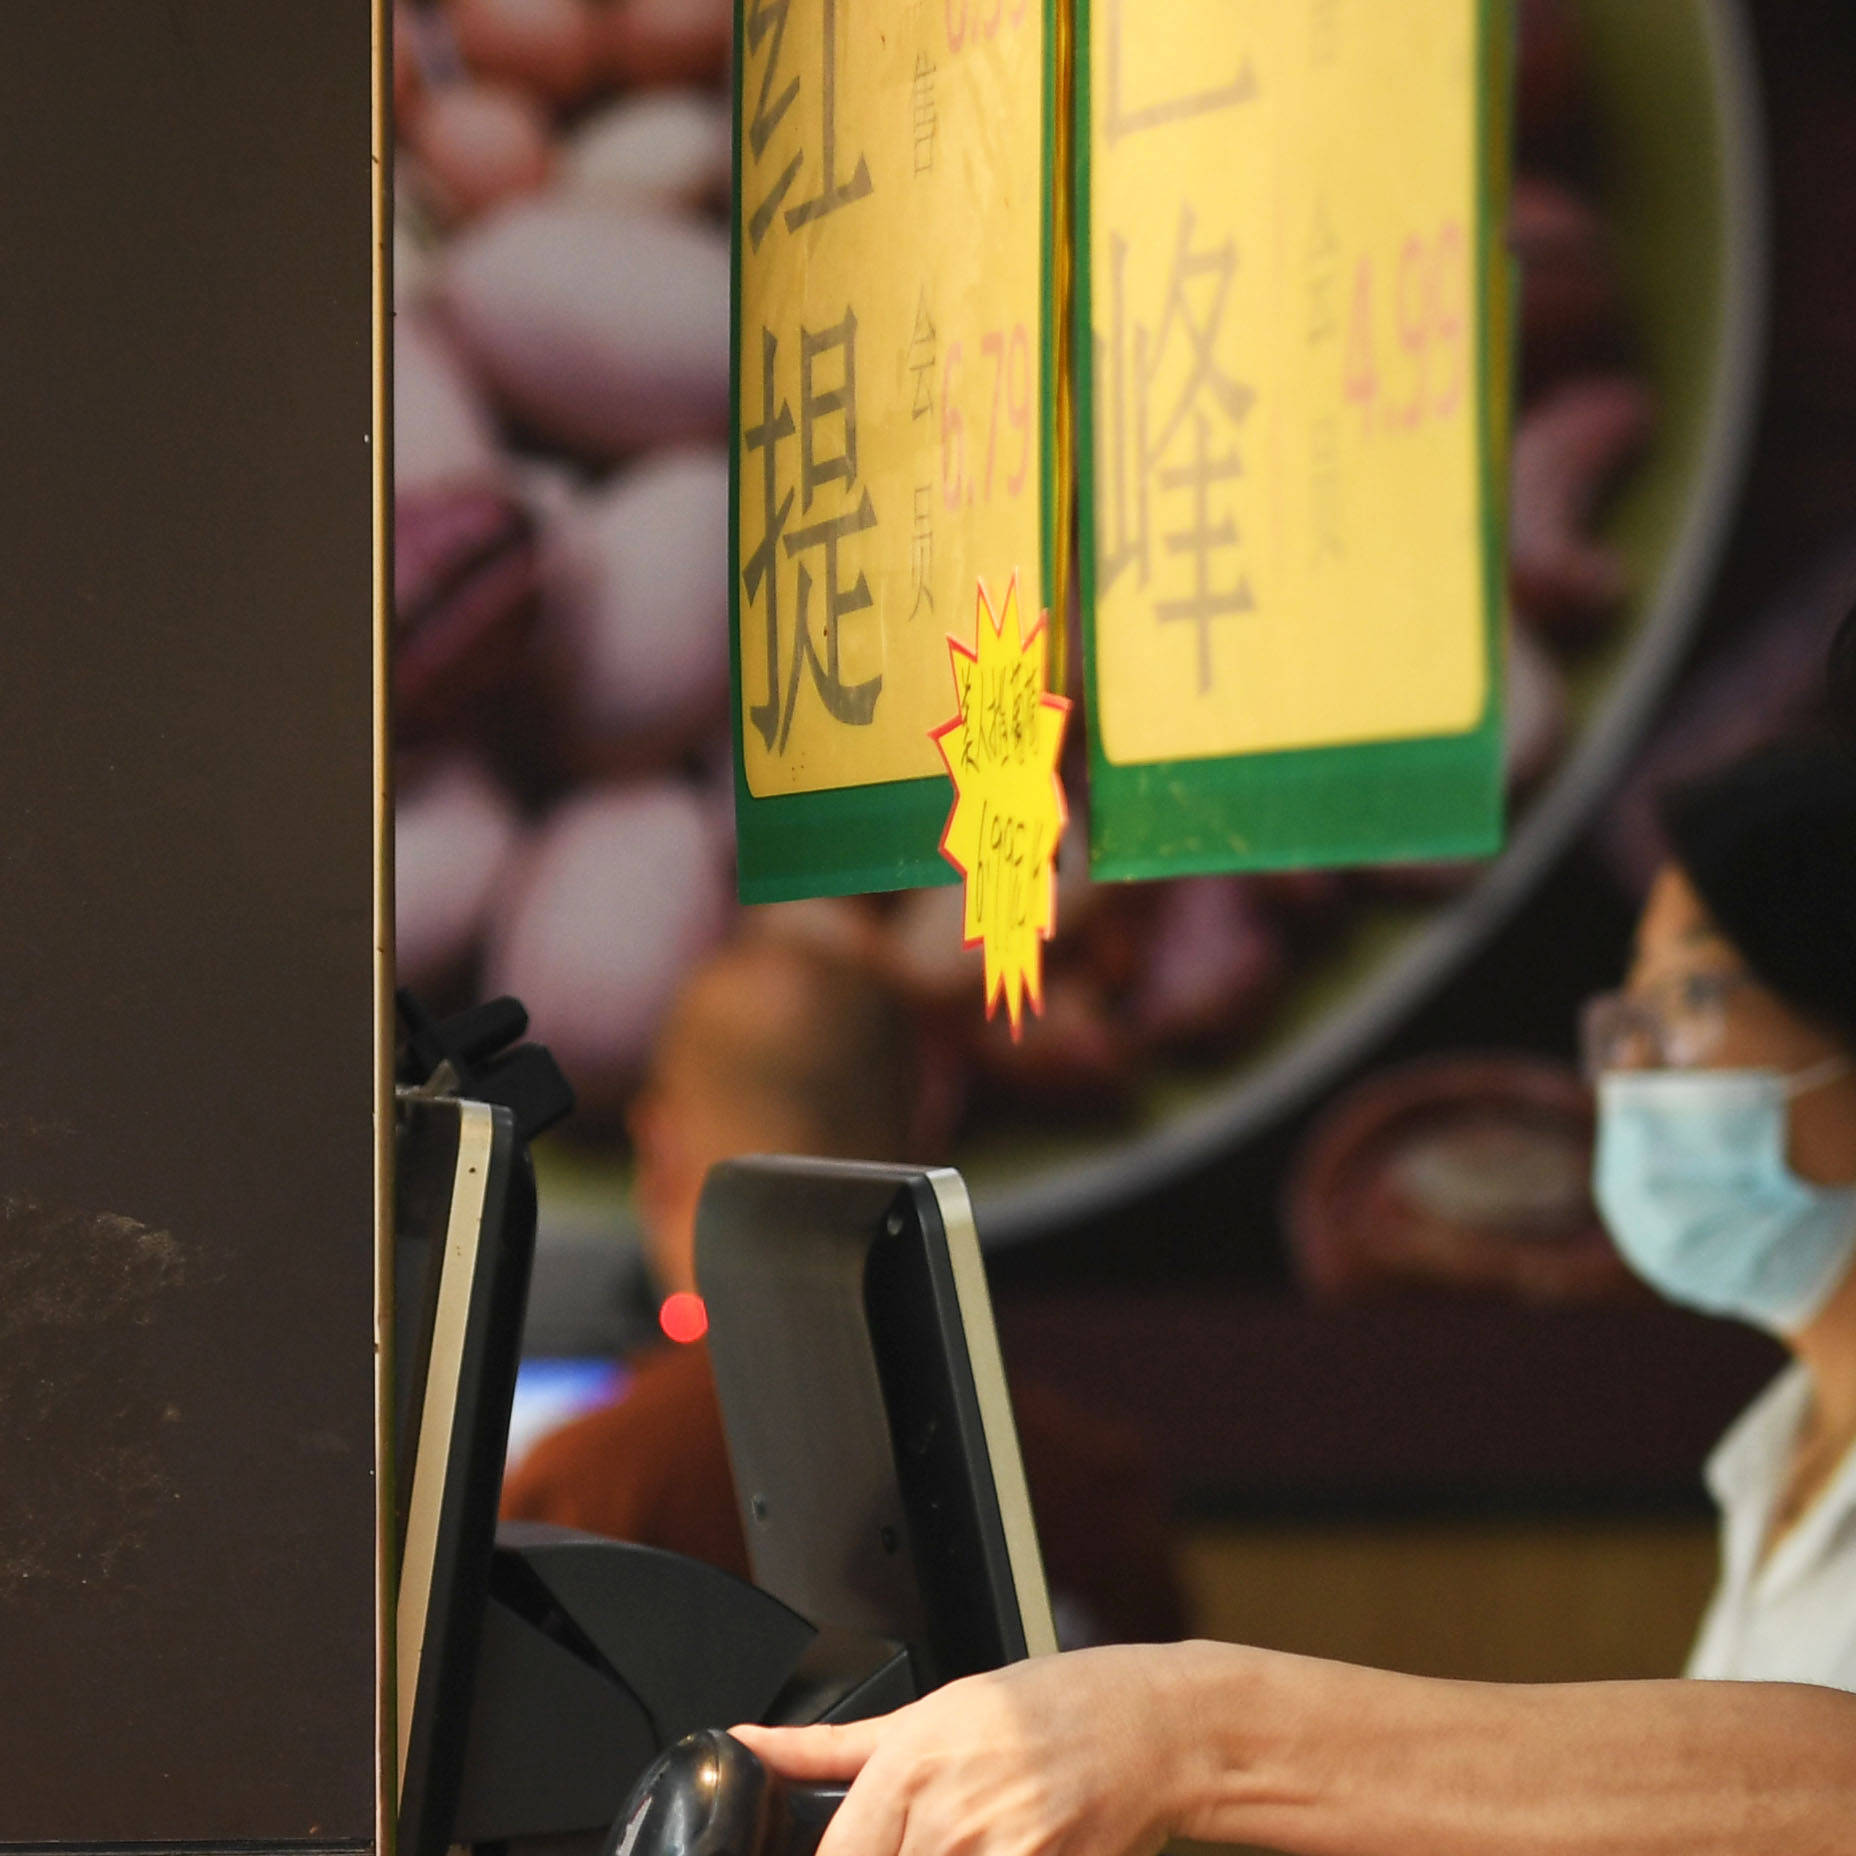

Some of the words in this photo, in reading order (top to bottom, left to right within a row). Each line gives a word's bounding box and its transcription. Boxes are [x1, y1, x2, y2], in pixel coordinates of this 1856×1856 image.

[940, 321, 1032, 512] 6.79
[1342, 218, 1466, 436] 4.99
[906, 283, 937, 623] 会员
